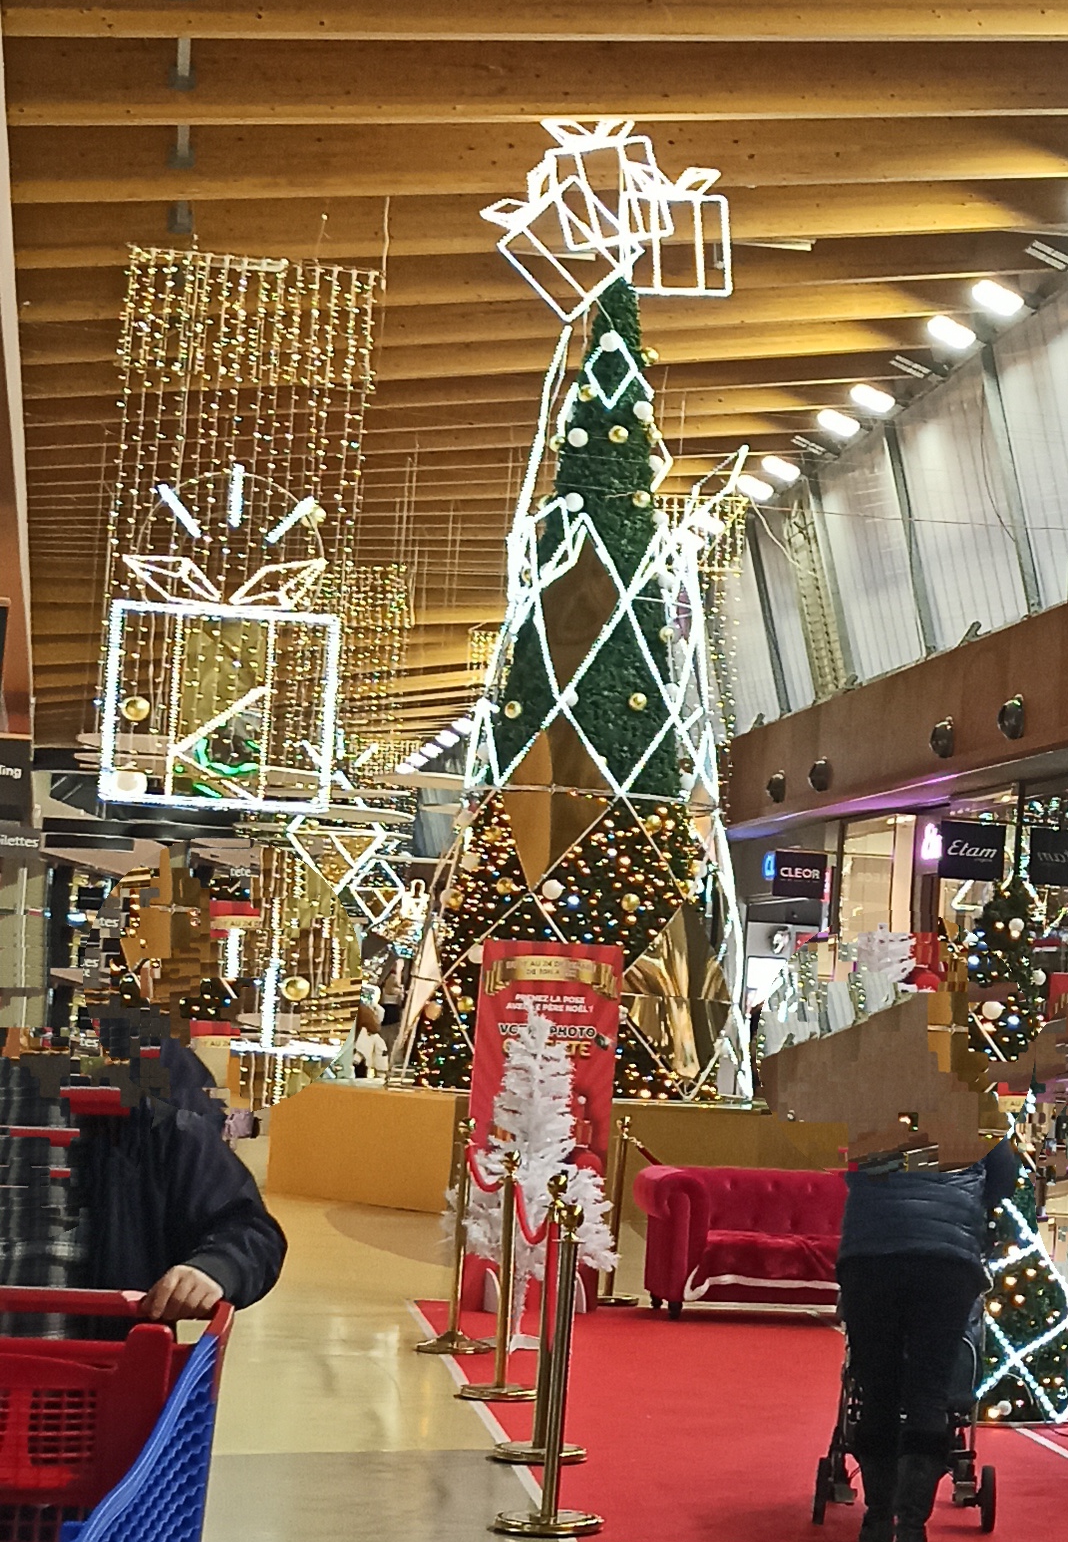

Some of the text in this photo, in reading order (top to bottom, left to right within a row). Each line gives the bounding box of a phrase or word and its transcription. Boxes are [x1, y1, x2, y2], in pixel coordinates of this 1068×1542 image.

[947, 839, 997, 859] Etam
[780, 867, 820, 879] CLEOR
[549, 1025, 597, 1038] PHOTO
